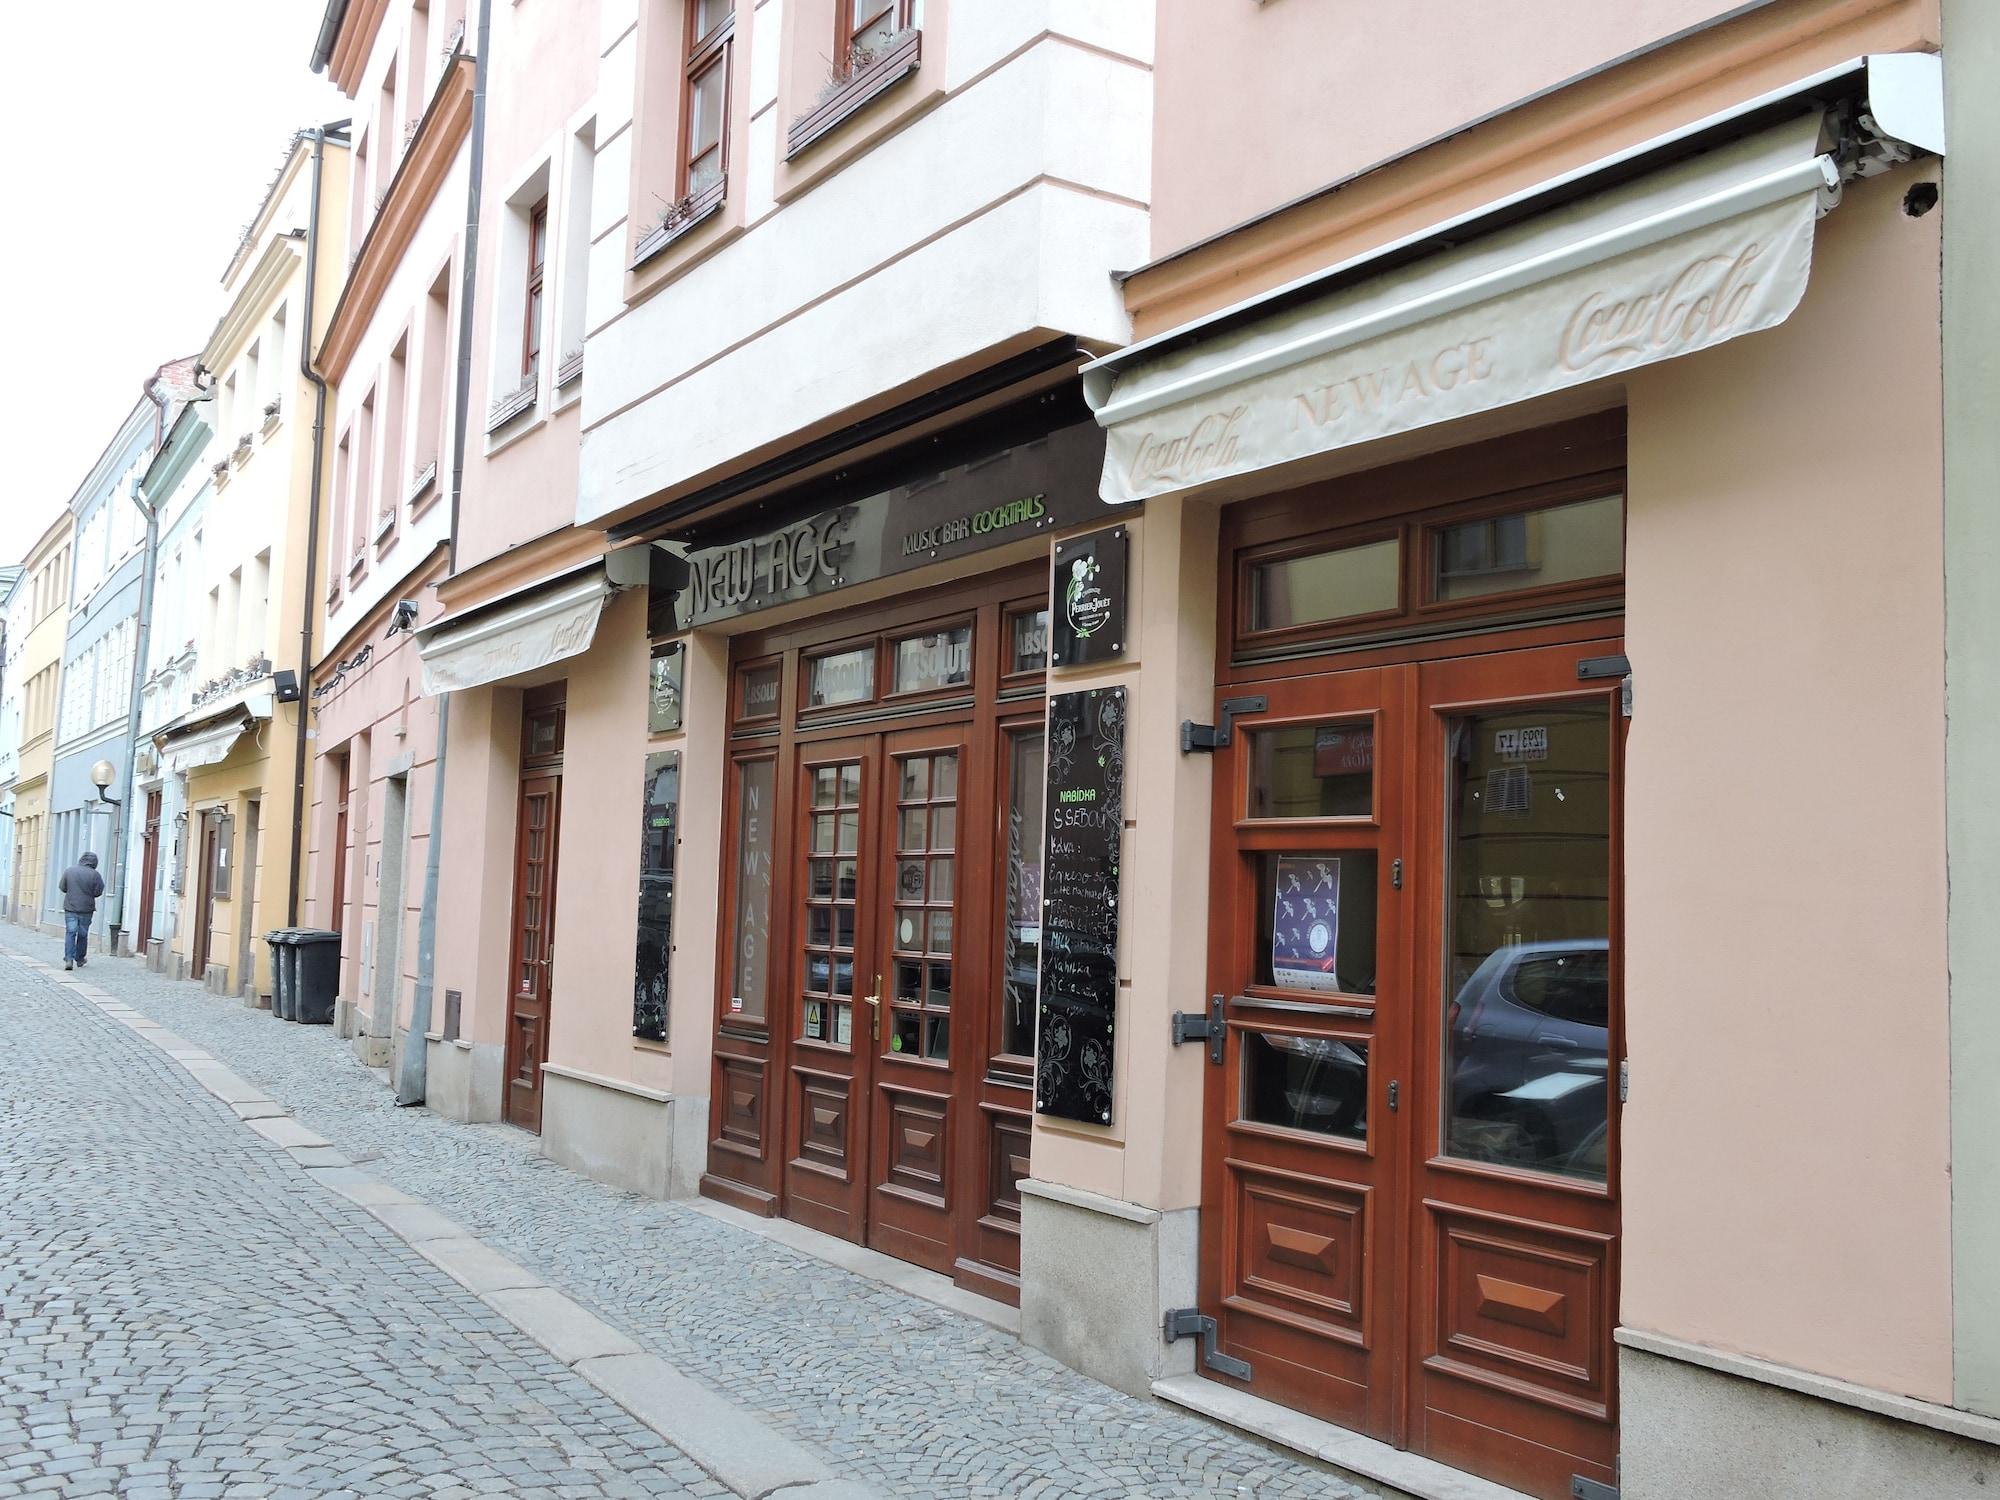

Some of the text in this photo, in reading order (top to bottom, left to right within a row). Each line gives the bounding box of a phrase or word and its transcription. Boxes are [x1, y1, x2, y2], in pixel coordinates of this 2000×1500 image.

[689, 514, 841, 617] NEW AGE
[902, 494, 1045, 556] MUSIC BAR COCKTAILS
[1060, 787, 1096, 803] NABÍDKA
[743, 786, 760, 992] NEW AGE
